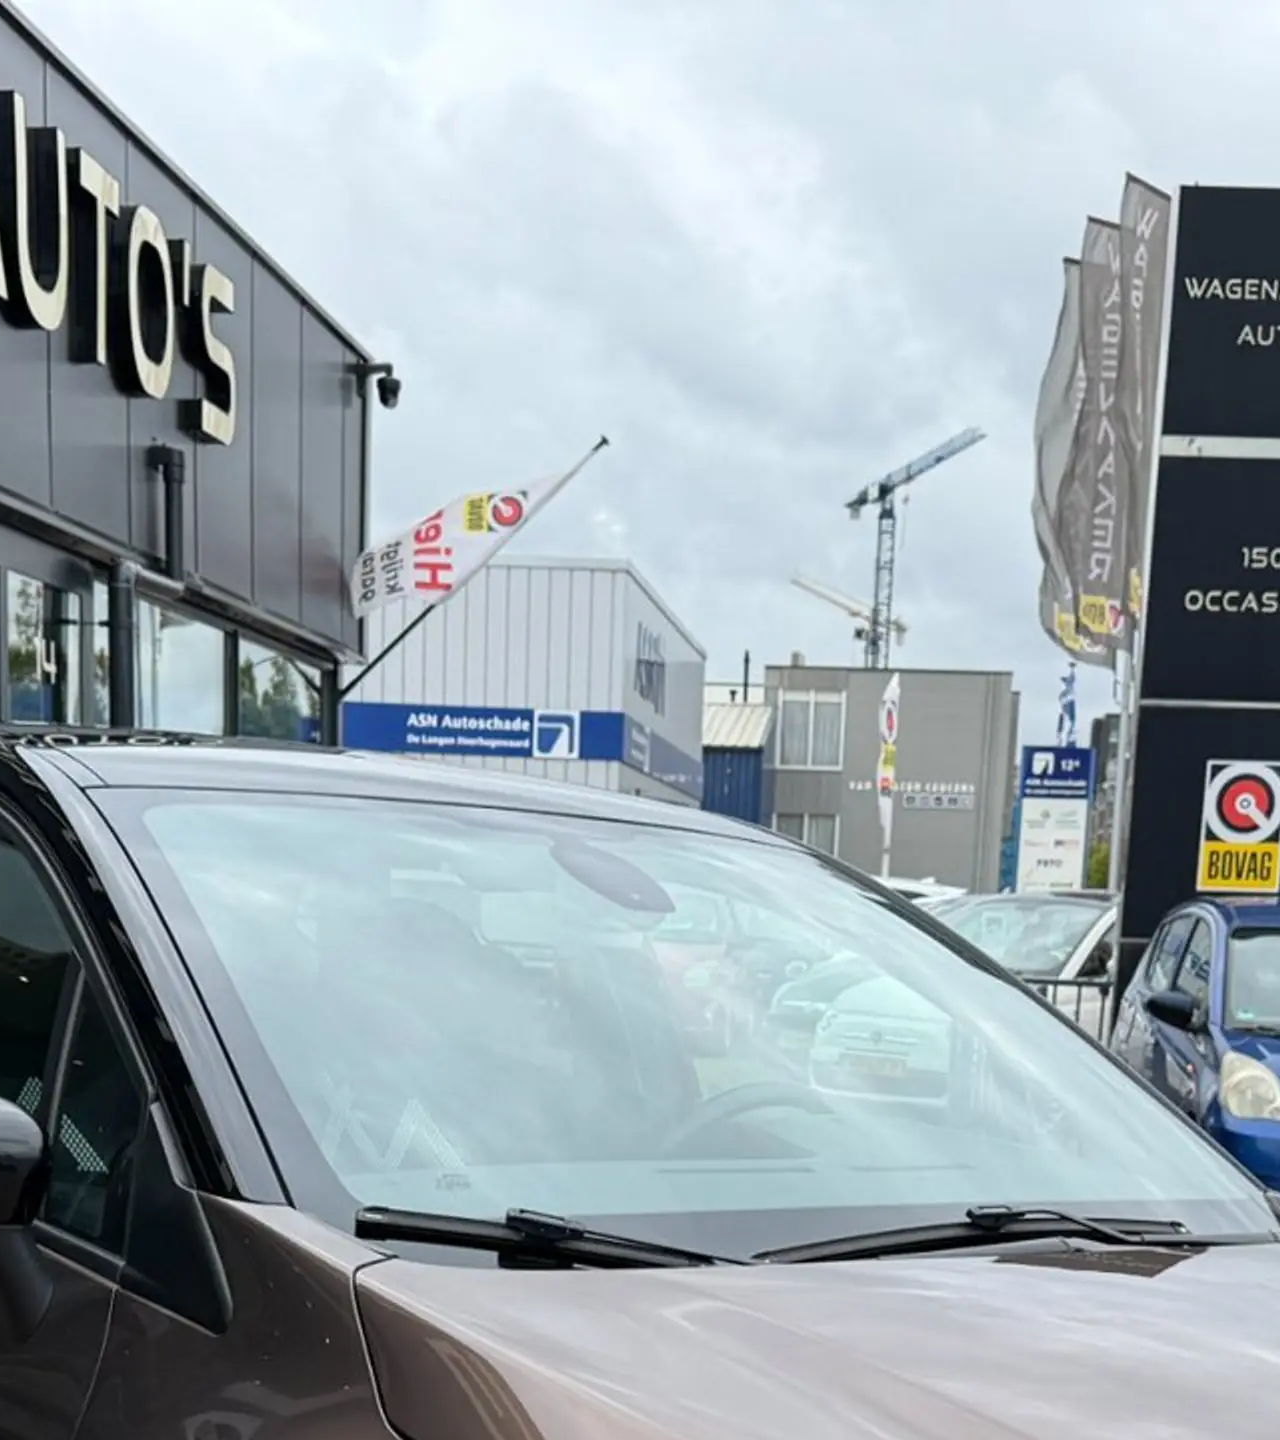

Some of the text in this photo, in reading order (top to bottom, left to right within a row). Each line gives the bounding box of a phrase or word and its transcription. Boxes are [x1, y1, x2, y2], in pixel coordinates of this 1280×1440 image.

[406, 712, 531, 732] ASN Autoschade
[1207, 849, 1273, 881] BOVAG
